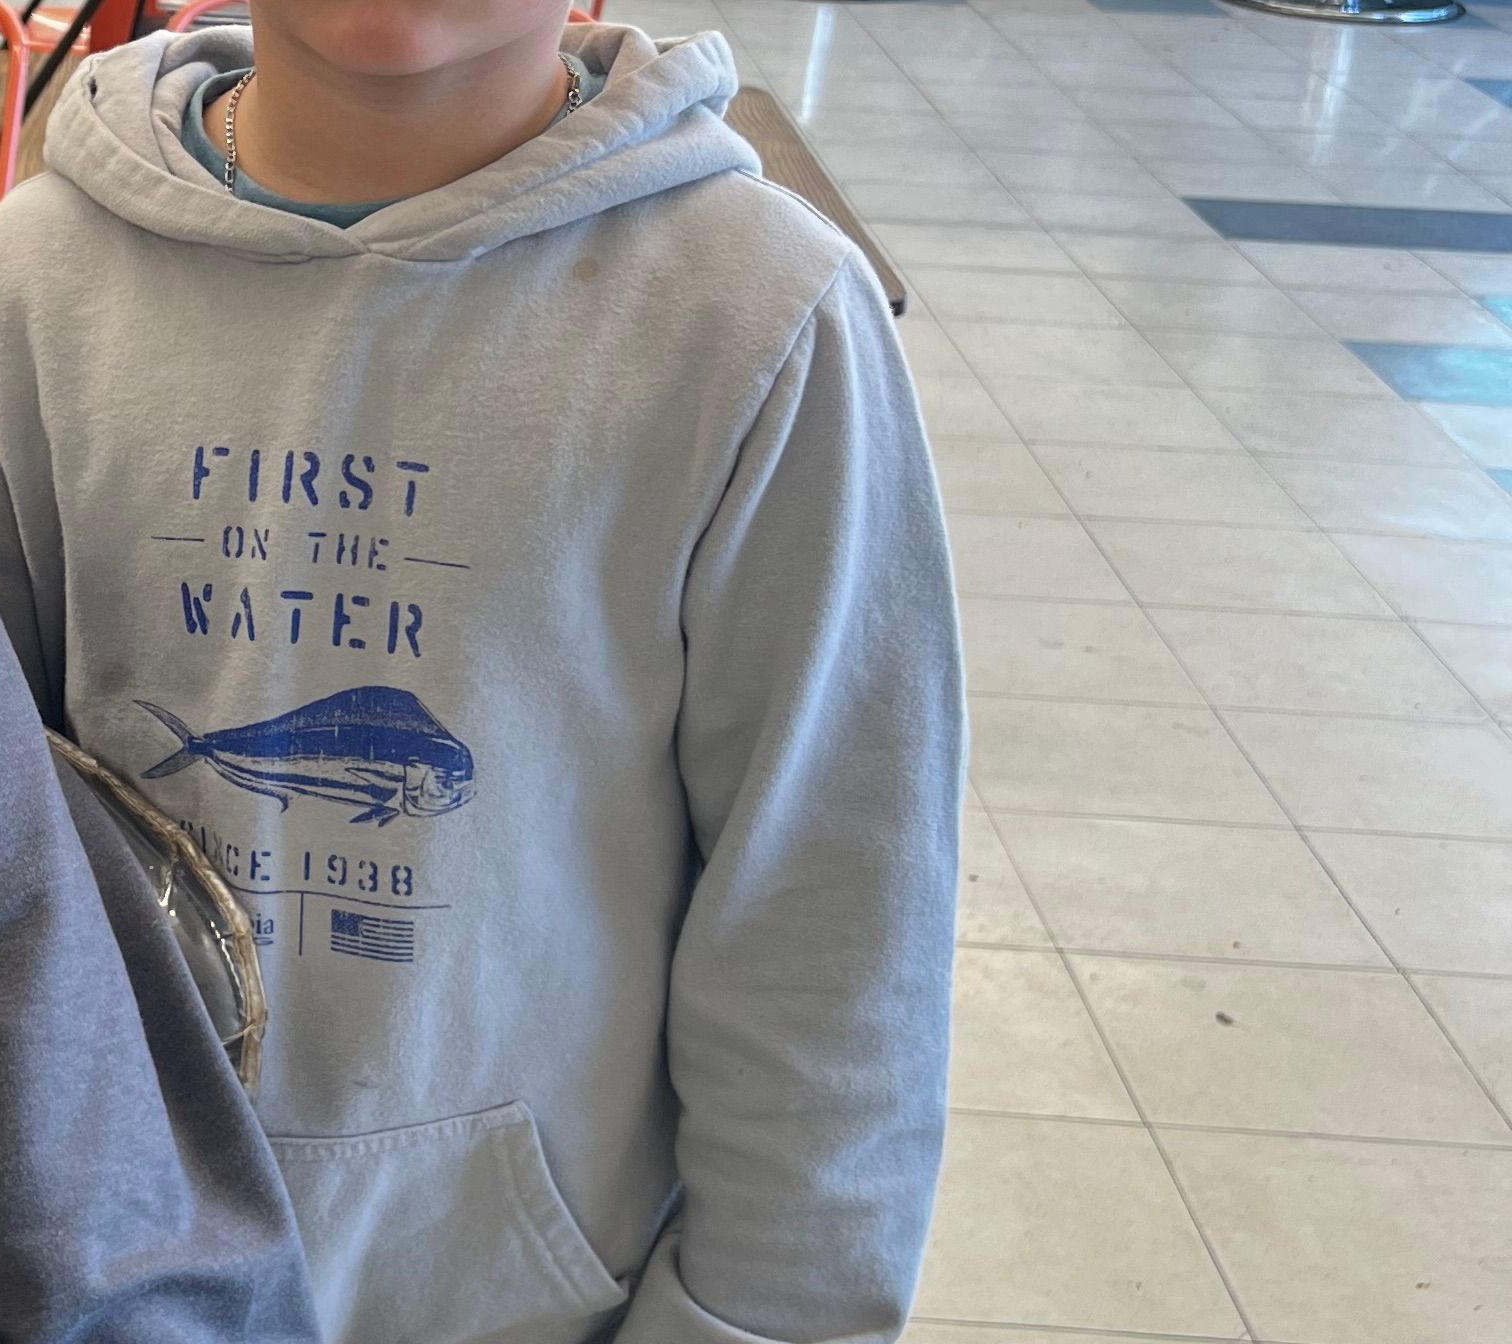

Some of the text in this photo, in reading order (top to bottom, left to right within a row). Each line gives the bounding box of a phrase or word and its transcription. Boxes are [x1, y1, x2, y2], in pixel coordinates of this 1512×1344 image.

[192, 445, 431, 518] FIRST
[222, 525, 390, 572] ON THE
[181, 581, 424, 658] WATER
[303, 850, 414, 897] 1938
